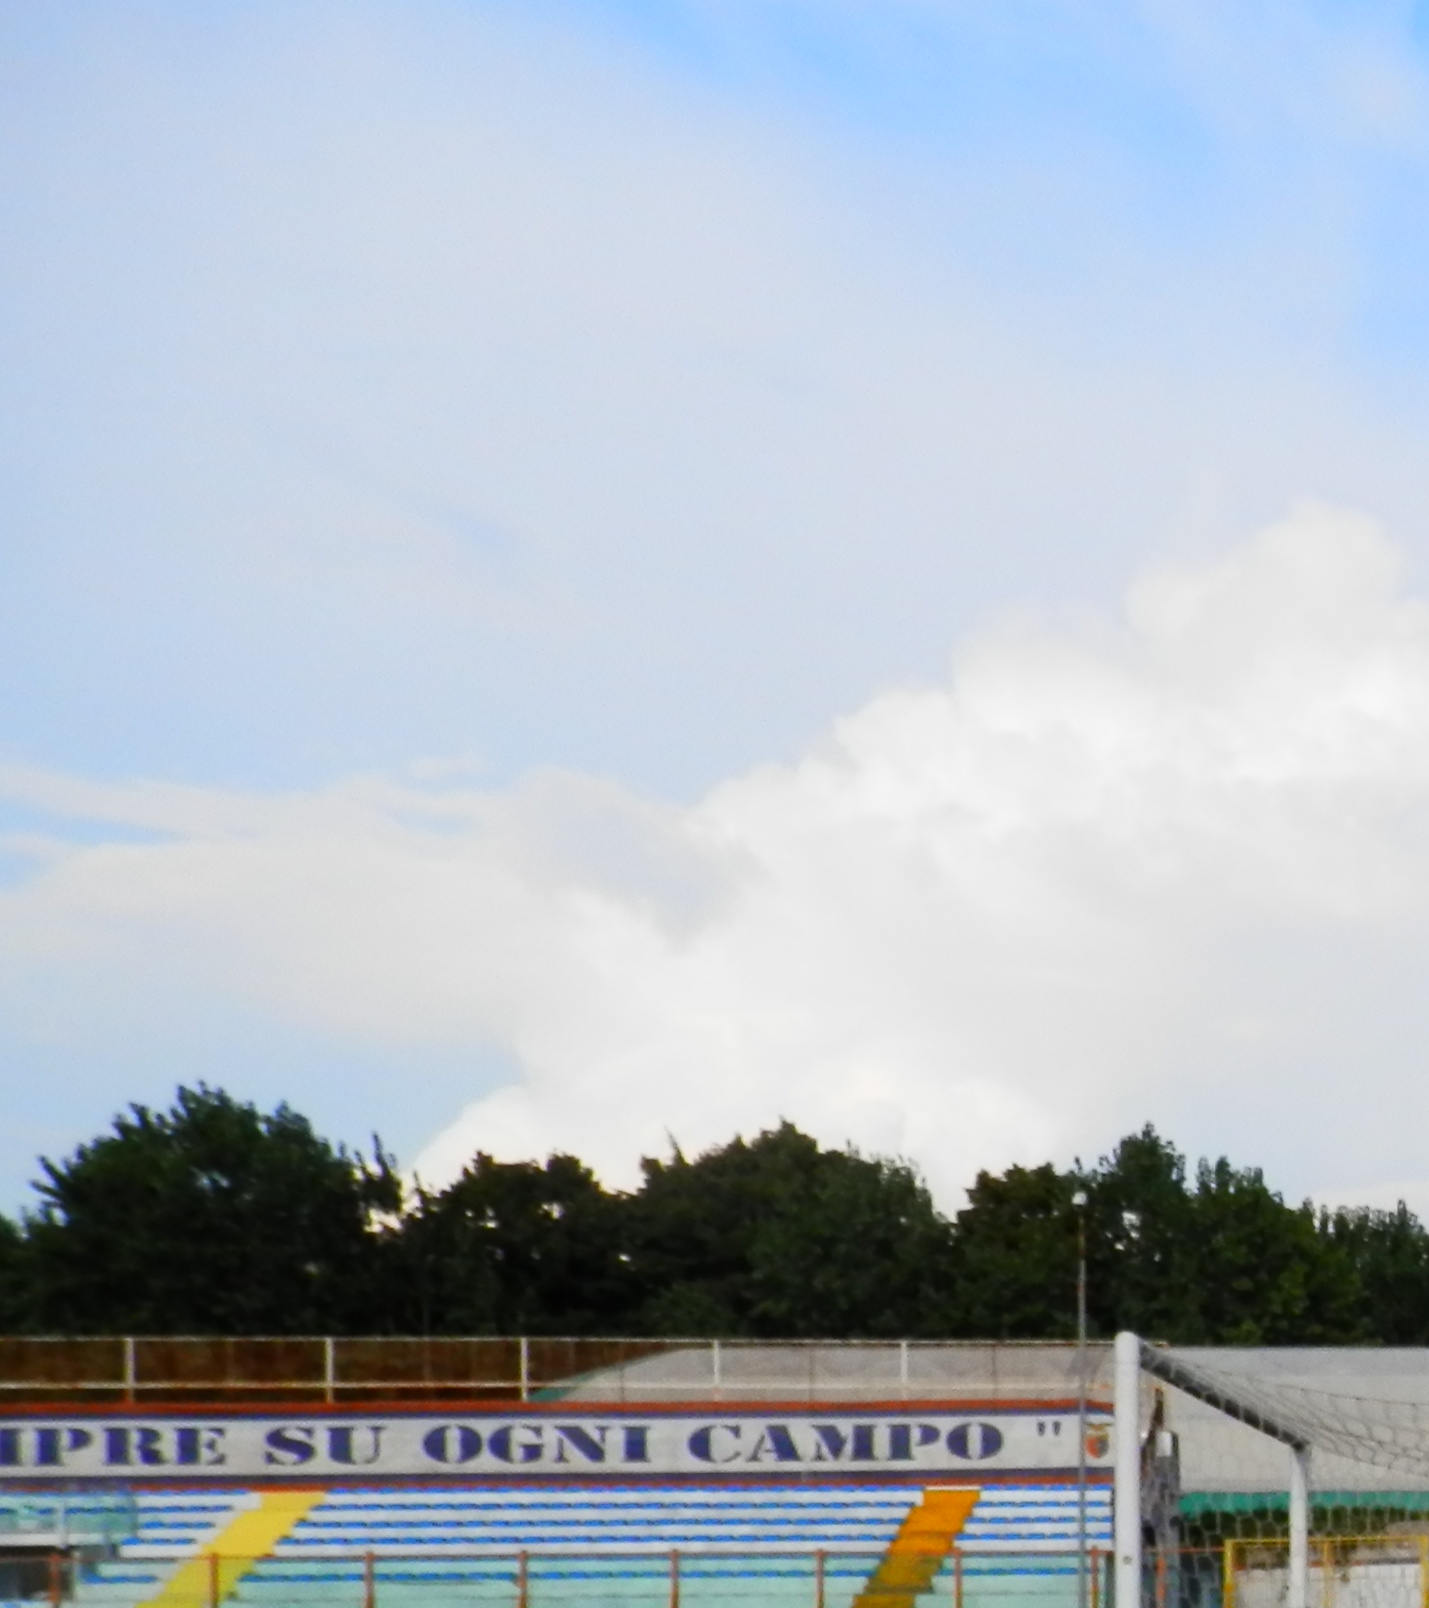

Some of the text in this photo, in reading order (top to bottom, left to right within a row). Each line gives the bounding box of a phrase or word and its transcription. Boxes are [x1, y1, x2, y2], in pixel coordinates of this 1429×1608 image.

[264, 1426, 386, 1466] SU
[422, 1424, 651, 1465] OGNI
[687, 1422, 1004, 1464] CAMPO
